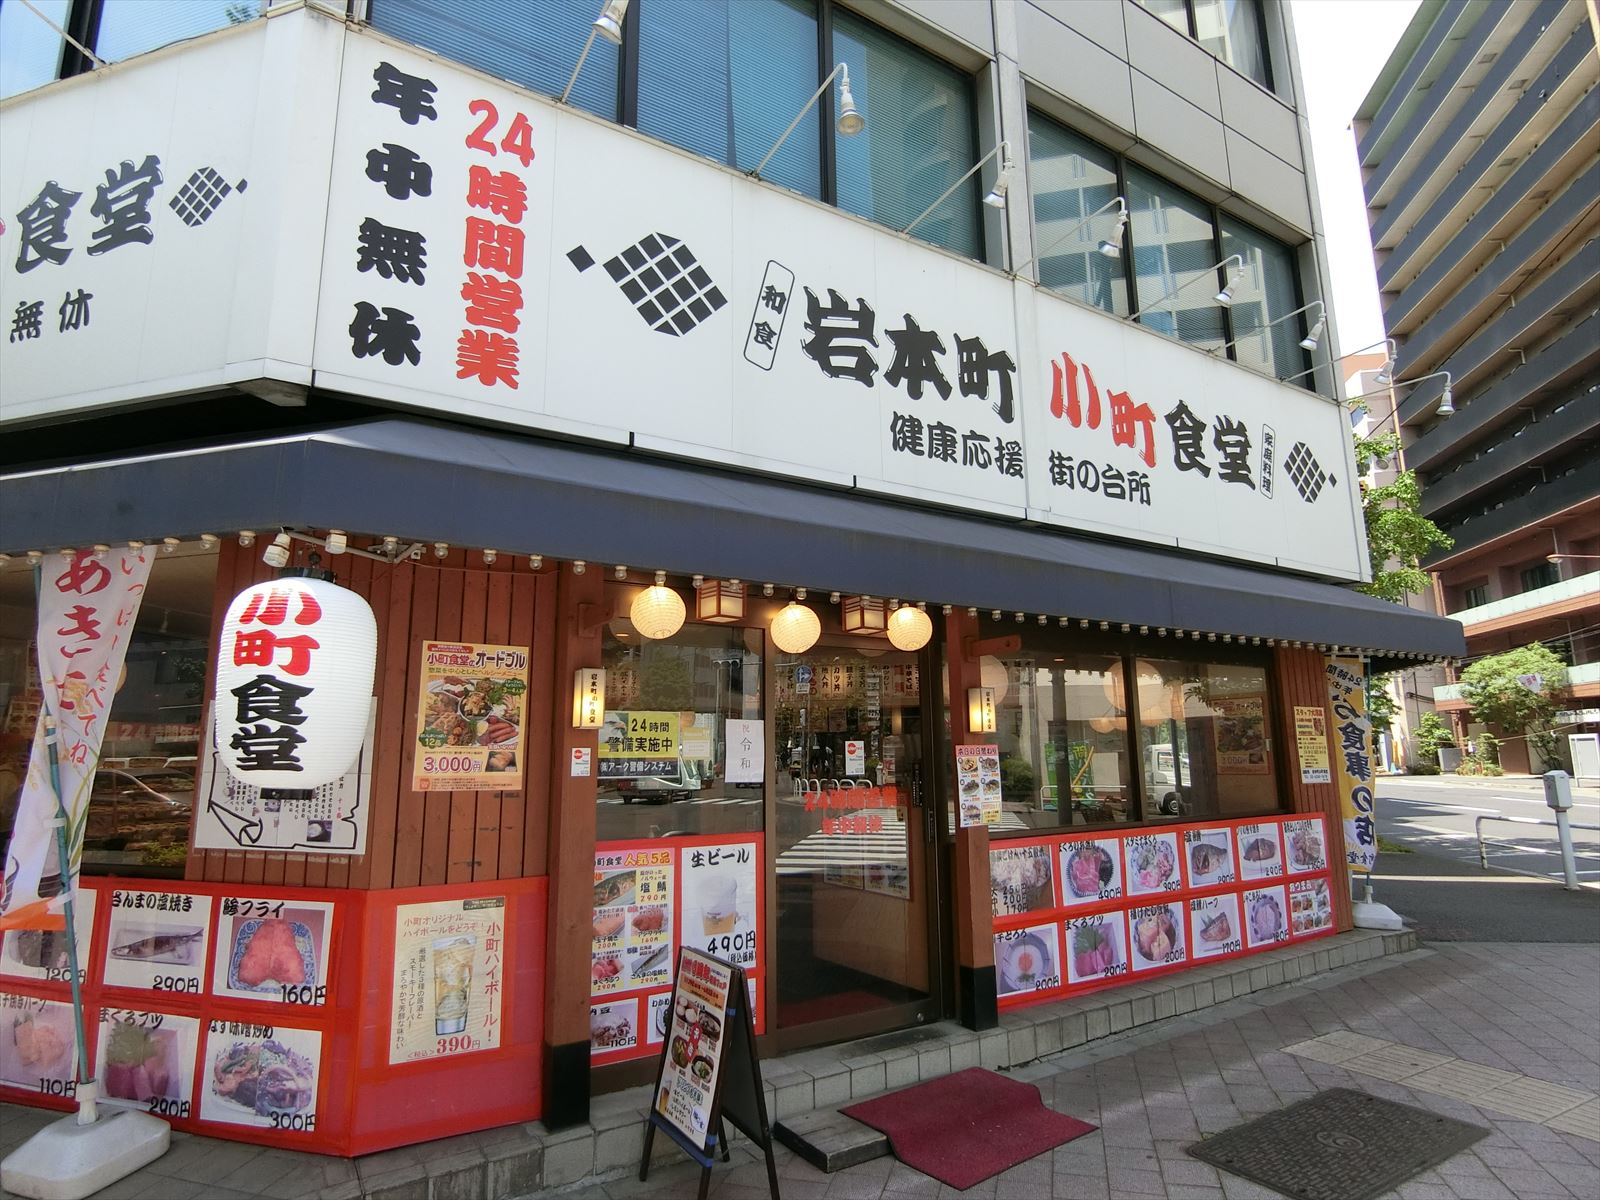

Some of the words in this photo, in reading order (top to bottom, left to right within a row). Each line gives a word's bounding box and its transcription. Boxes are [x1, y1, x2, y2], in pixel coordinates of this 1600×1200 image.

[16, 155, 164, 274] 食堂
[349, 61, 437, 366] 年中無休
[456, 99, 535, 390] 24時間営業
[10, 289, 93, 343] 無休
[754, 284, 787, 351] 和食
[800, 286, 1017, 423] 岩本町
[1050, 352, 1256, 490] 小町食堂
[891, 411, 1025, 479] 健康応援
[1050, 450, 1151, 506] 街の台所
[229, 587, 321, 772] 小町食堂
[631, 718, 670, 733] 24時間
[607, 736, 673, 752] 警備実施中
[423, 756, 480, 773] 3,000円
[691, 850, 750, 868] 生ビール
[112, 891, 193, 913] さんまの塩焼き
[707, 930, 756, 954] 490円
[152, 974, 199, 994] 290円
[483, 921, 500, 1042] 小町ハイボール！
[281, 984, 326, 1005] 160円
[436, 1034, 481, 1054] 390円
[610, 1035, 637, 1048] 110円
[39, 1077, 77, 1098] 110円
[150, 1099, 190, 1117] 290円
[270, 1113, 316, 1132] 300円
